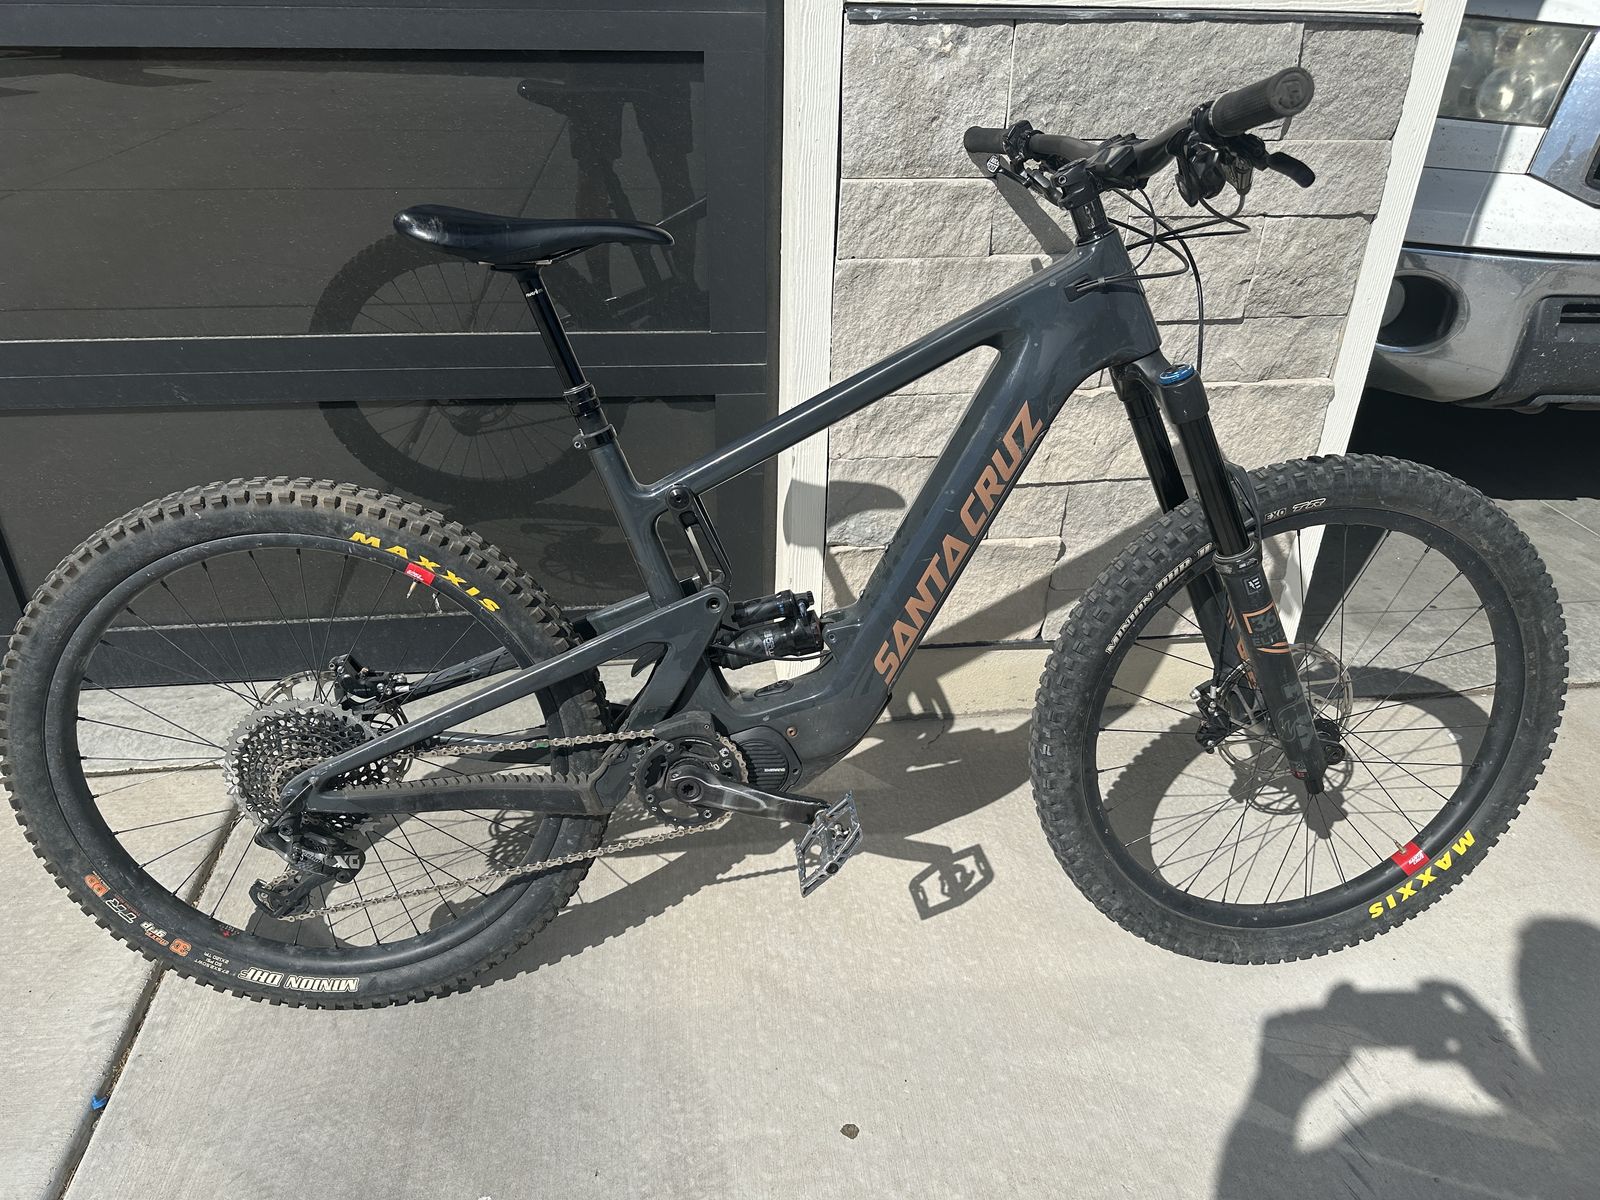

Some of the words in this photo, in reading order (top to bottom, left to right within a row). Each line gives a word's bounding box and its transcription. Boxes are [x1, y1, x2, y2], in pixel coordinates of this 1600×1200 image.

[1265, 508, 1287, 521] EXO
[1292, 497, 1327, 512] TR
[872, 535, 971, 684] SANTA
[960, 400, 1045, 538] CRUZ
[349, 531, 502, 613] MAXXIS
[1105, 590, 1155, 655] MINION
[1369, 829, 1476, 919] MAXXIS
[105, 897, 137, 924] TR
[238, 967, 284, 987] DHF
[284, 974, 360, 993] MINION
